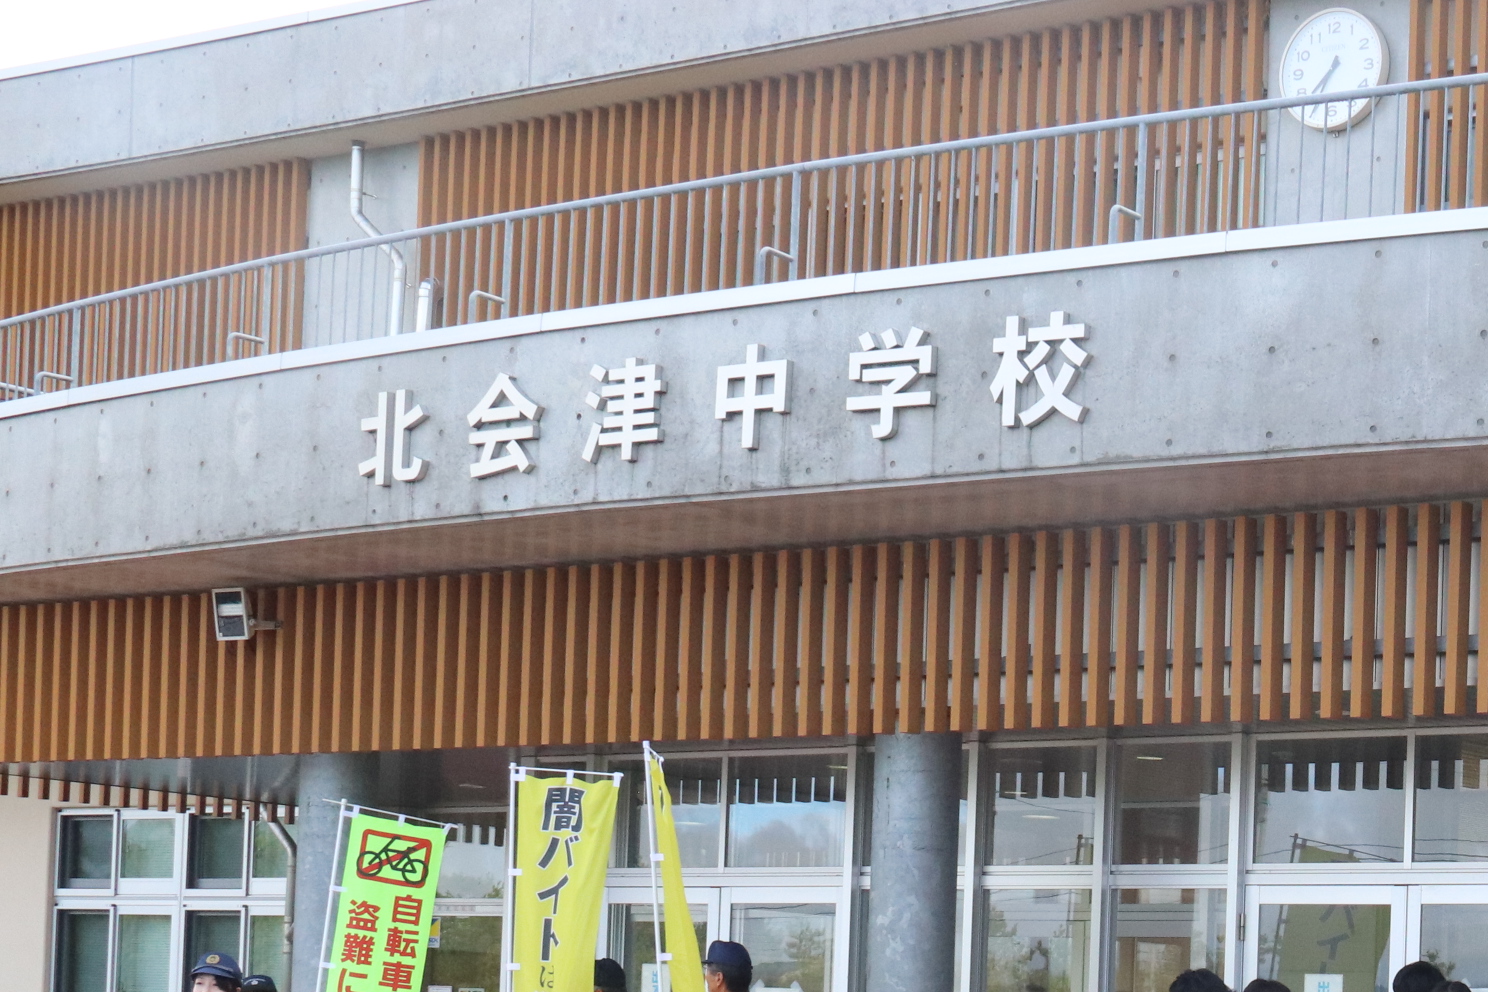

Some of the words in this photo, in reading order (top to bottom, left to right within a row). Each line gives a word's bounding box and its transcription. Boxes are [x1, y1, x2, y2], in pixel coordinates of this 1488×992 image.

[1327, 21, 1341, 34] 12
[1350, 24, 1354, 35] 1
[1310, 32, 1322, 45] 11
[1359, 38, 1369, 51] 2
[1297, 50, 1310, 62] 10
[1363, 58, 1374, 70] 3
[1293, 69, 1304, 81] 9
[1357, 78, 1369, 88] 4
[1327, 105, 1338, 117] 6
[358, 310, 1093, 487] 北会津中学校
